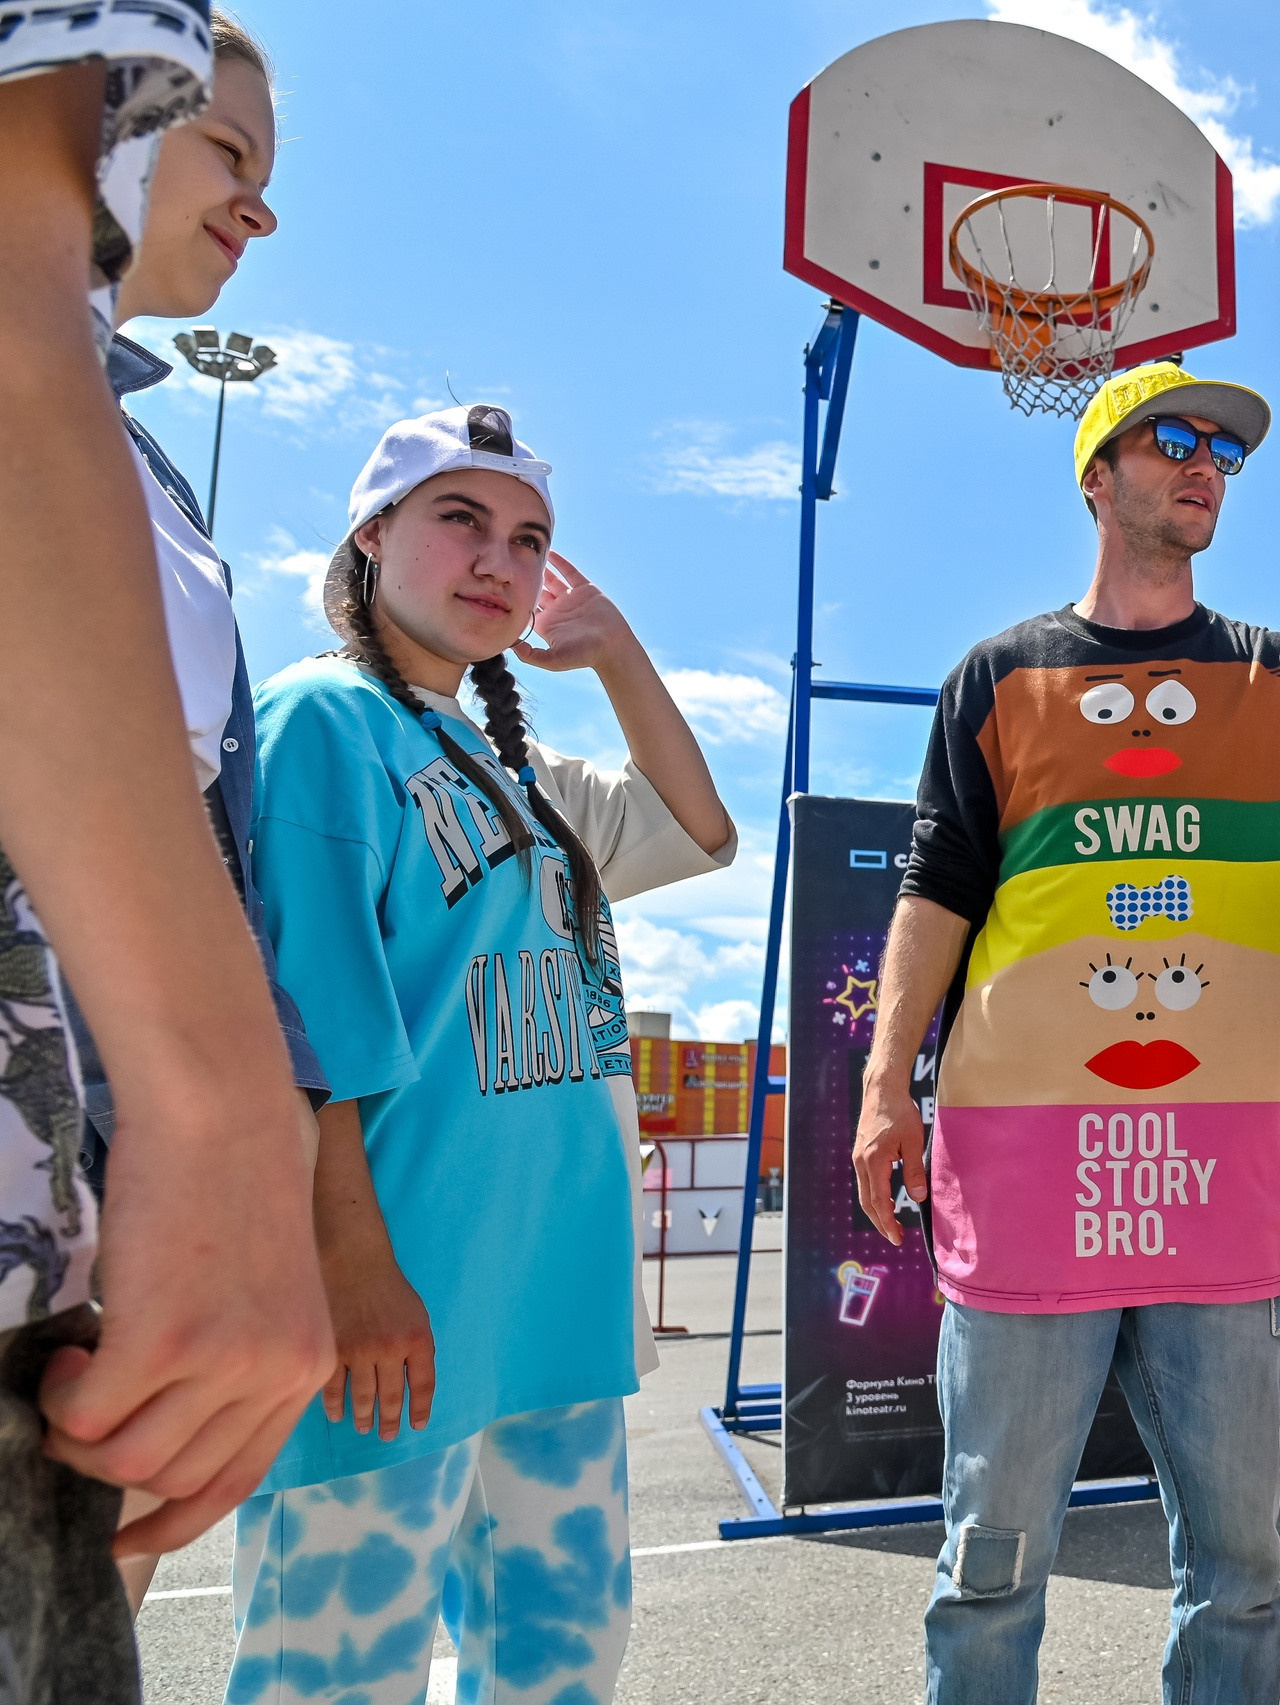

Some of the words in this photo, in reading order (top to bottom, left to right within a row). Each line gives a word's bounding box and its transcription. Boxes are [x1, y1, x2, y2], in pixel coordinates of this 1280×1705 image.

[1073, 803, 1202, 856] SWAG
[585, 988, 611, 1009] 1886
[1077, 1112, 1189, 1160] COOL
[1075, 1158, 1218, 1207] STORY
[1074, 1208, 1178, 1258] BRO.
[845, 1378, 895, 1391] Формула
[896, 1375, 925, 1387] Кино
[845, 1391, 853, 1403] 3
[854, 1392, 900, 1404] уровень
[845, 1404, 907, 1416] kinoteatr.ru
